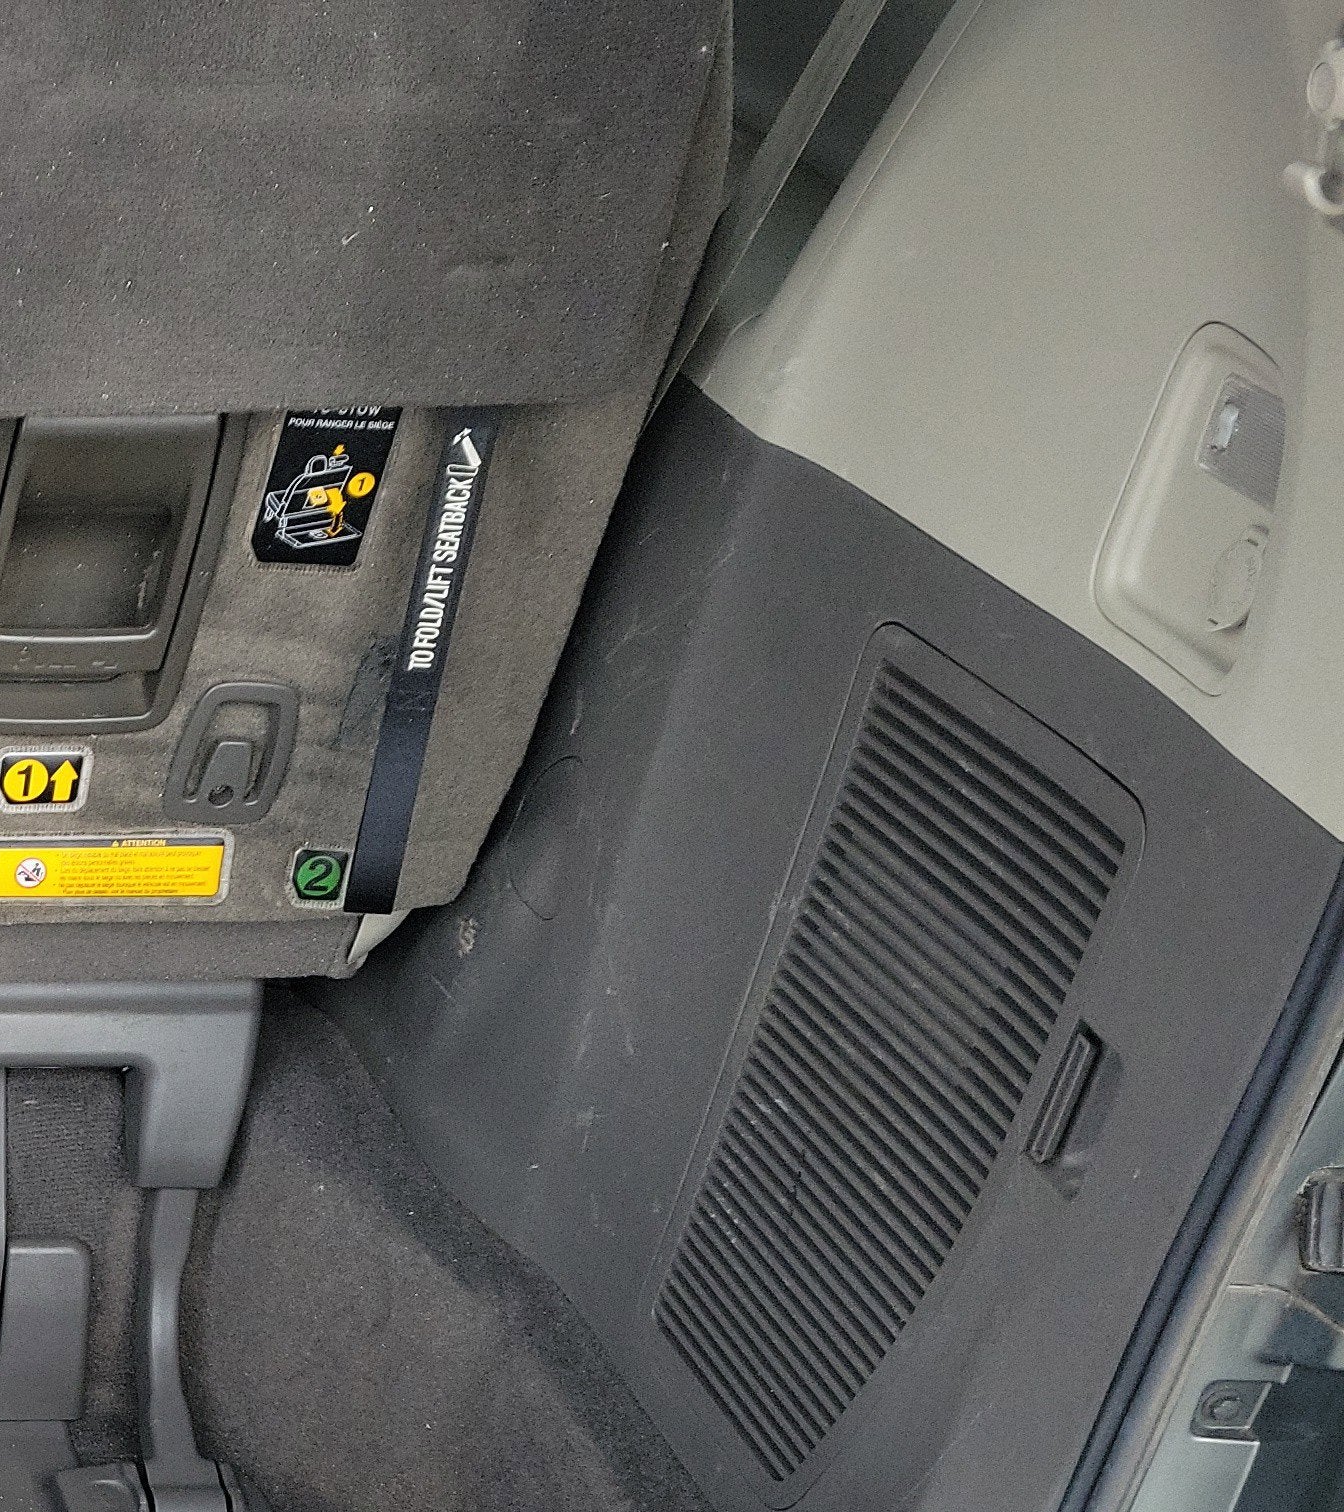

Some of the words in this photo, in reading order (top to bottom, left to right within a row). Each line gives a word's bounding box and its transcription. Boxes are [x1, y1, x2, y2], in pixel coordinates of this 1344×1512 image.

[288, 417, 315, 428] POUR
[354, 420, 366, 430] LE
[432, 477, 474, 563] SEATBACK
[413, 564, 454, 649] FOLD/LIFT
[408, 650, 435, 671] TO
[121, 839, 166, 847] ATTENTION
[304, 858, 333, 891] 2
